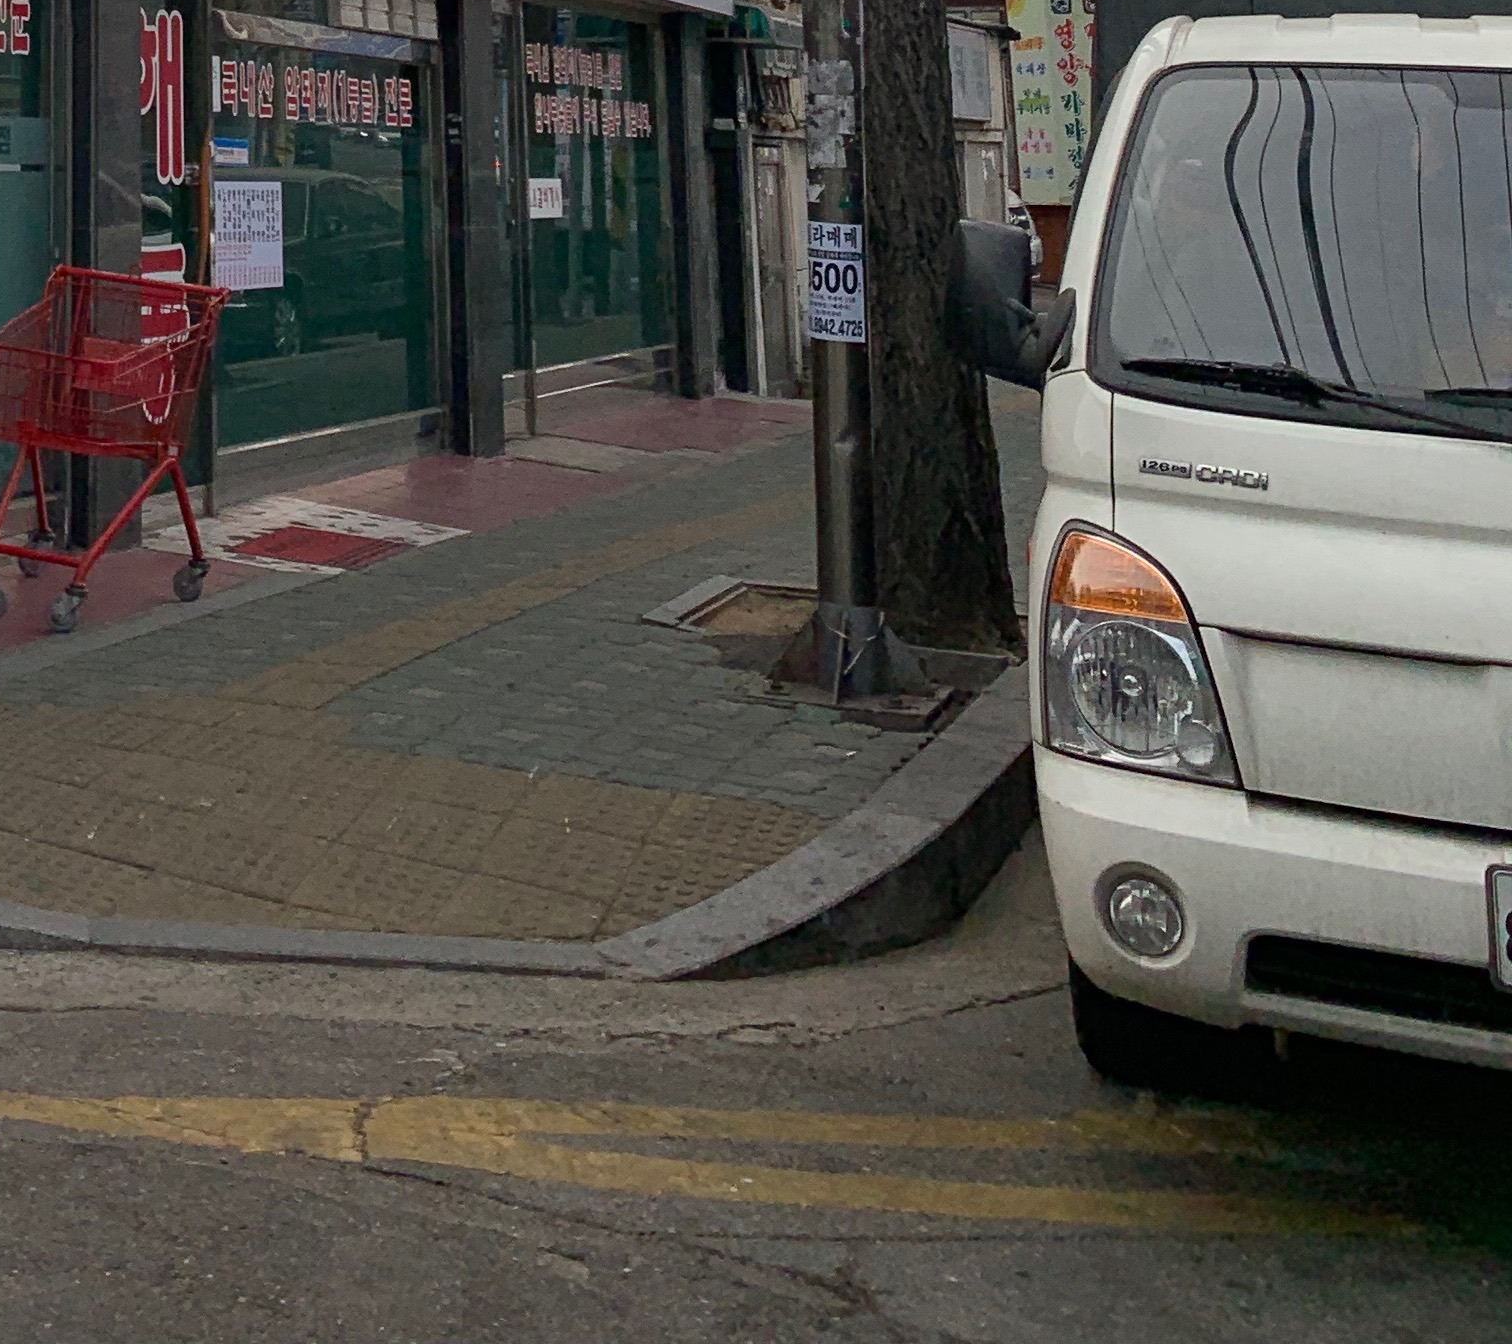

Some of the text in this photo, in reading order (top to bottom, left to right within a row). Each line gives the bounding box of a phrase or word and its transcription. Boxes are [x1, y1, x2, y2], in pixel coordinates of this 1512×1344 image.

[222, 60, 274, 118] 국내산
[384, 75, 413, 128] 전문
[808, 222, 857, 249] 라매매
[809, 259, 858, 294] 500
